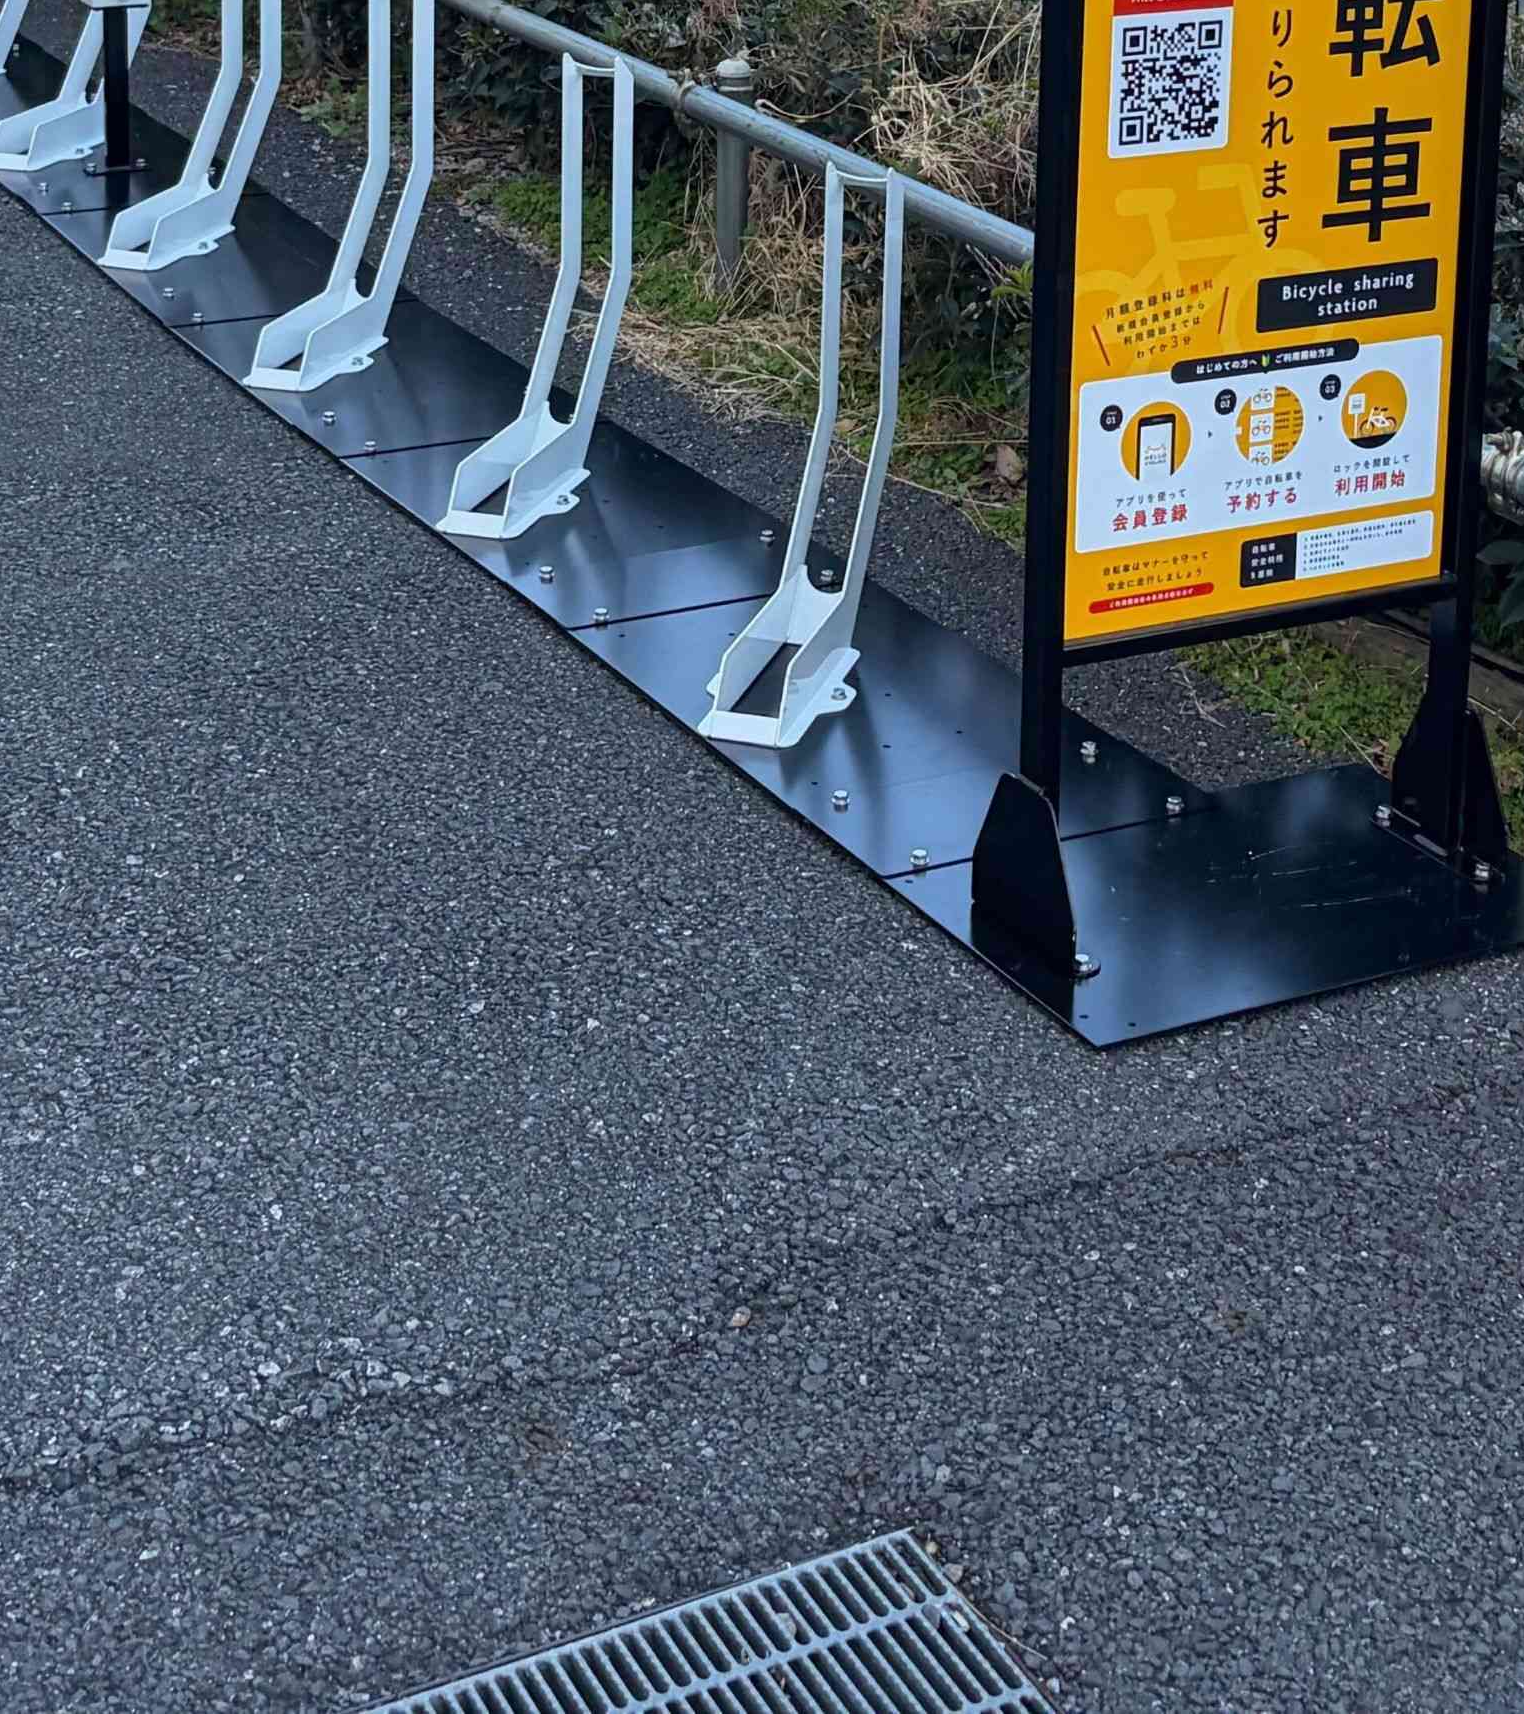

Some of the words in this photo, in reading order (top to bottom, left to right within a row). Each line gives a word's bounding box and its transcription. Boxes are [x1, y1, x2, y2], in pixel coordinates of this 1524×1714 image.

[1282, 278, 1343, 302] Bicycle
[1353, 272, 1415, 292] sharing
[1317, 297, 1378, 317] station
[1334, 469, 1406, 497] 利用開始
[1227, 486, 1299, 514] 予約する
[1112, 503, 1188, 533] 会員登録
